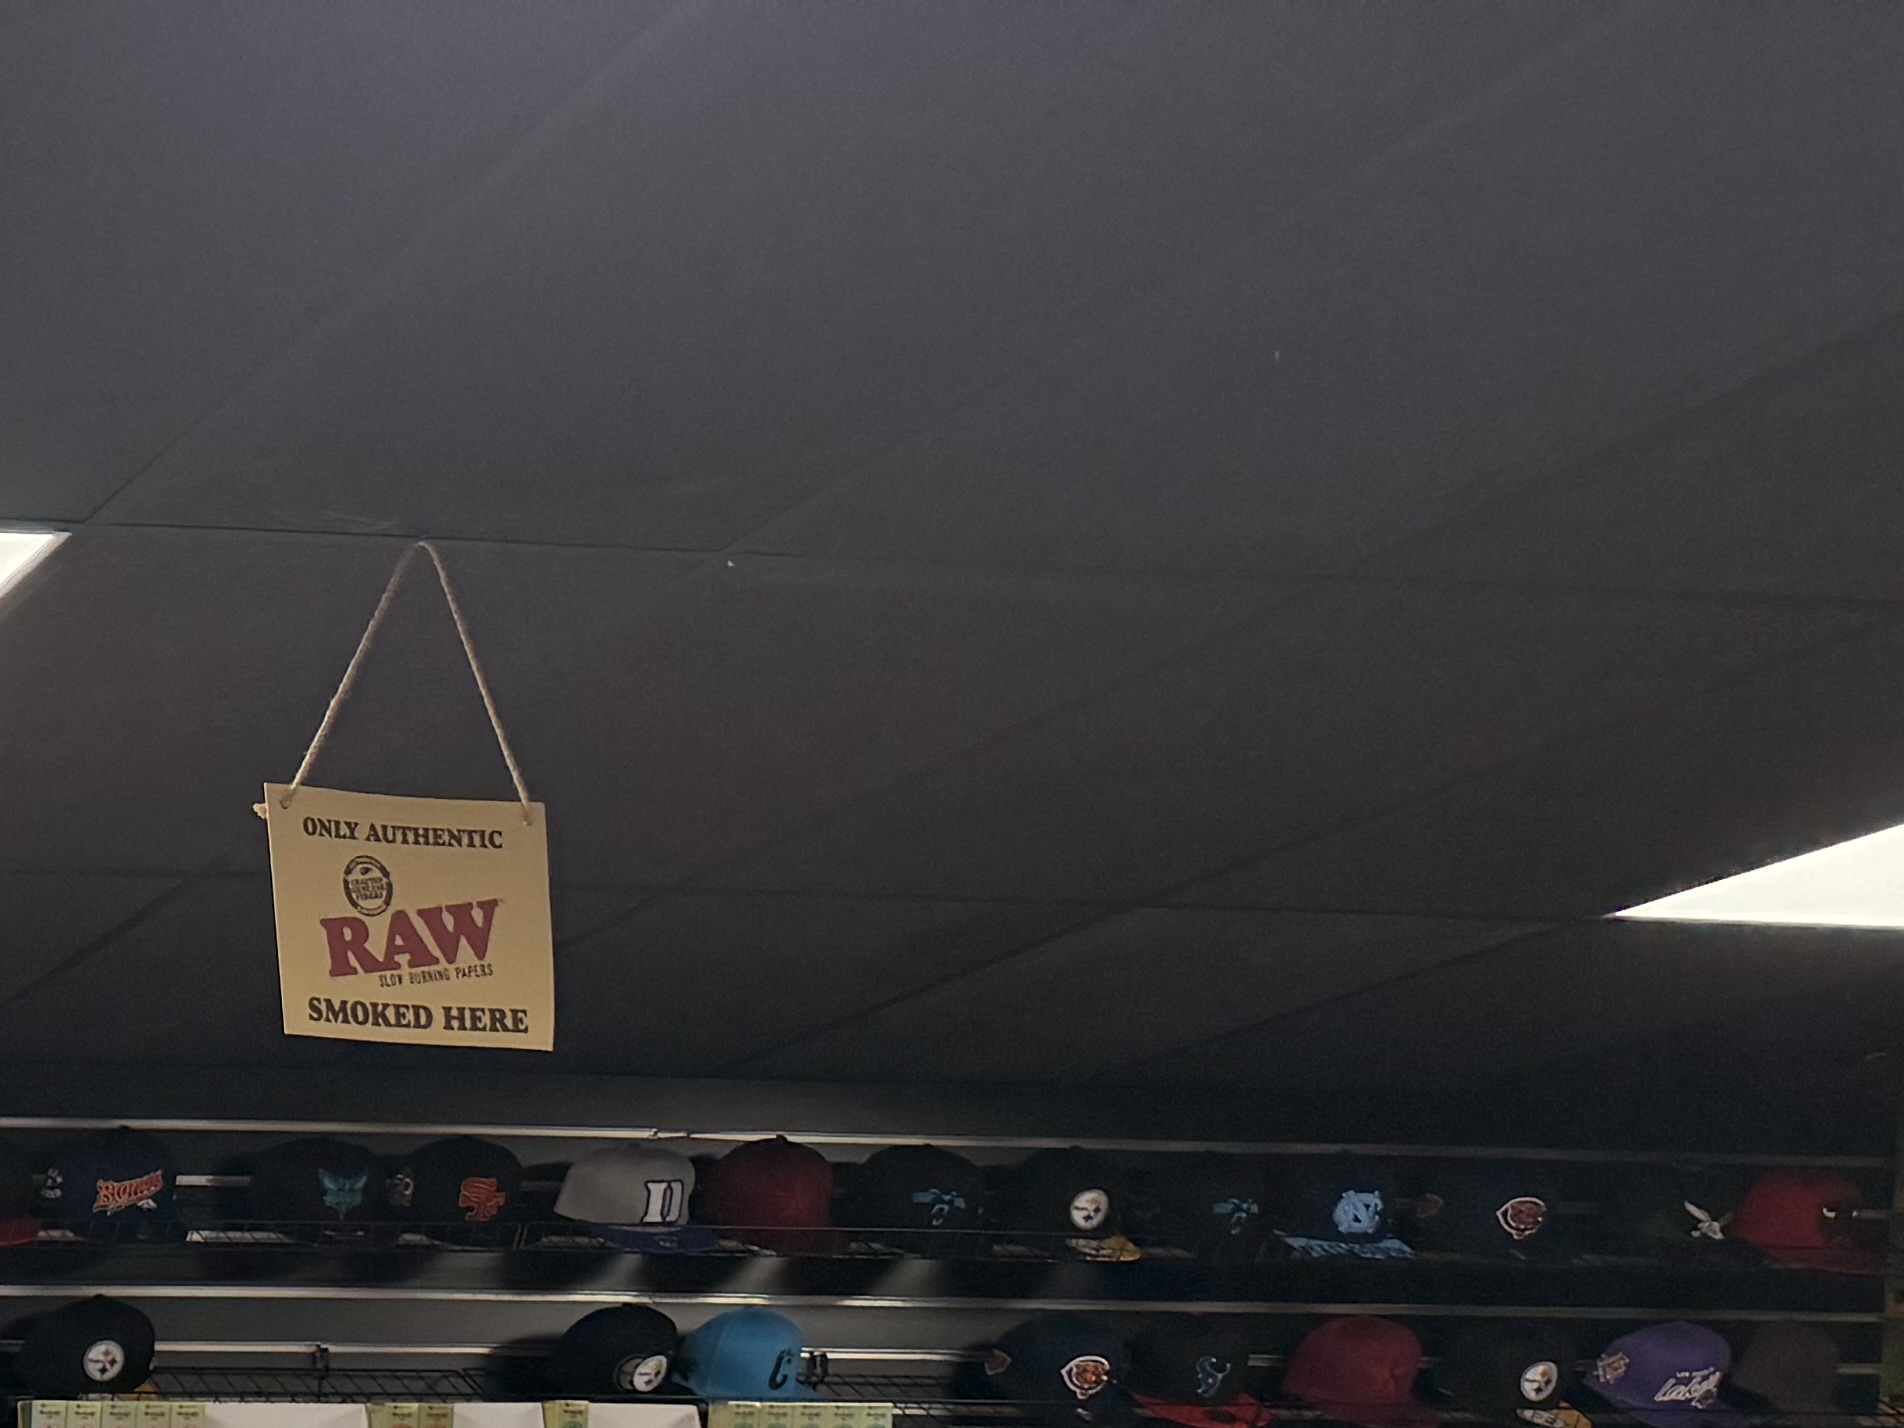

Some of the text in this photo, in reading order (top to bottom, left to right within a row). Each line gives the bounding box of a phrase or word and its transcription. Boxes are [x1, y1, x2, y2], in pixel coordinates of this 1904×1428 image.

[303, 816, 503, 849] ONLY AUTHENTIC
[320, 898, 499, 977] RAW
[379, 963, 493, 988] SLOW BURNING PAPERS
[308, 997, 529, 1034] SMOKED HERE
